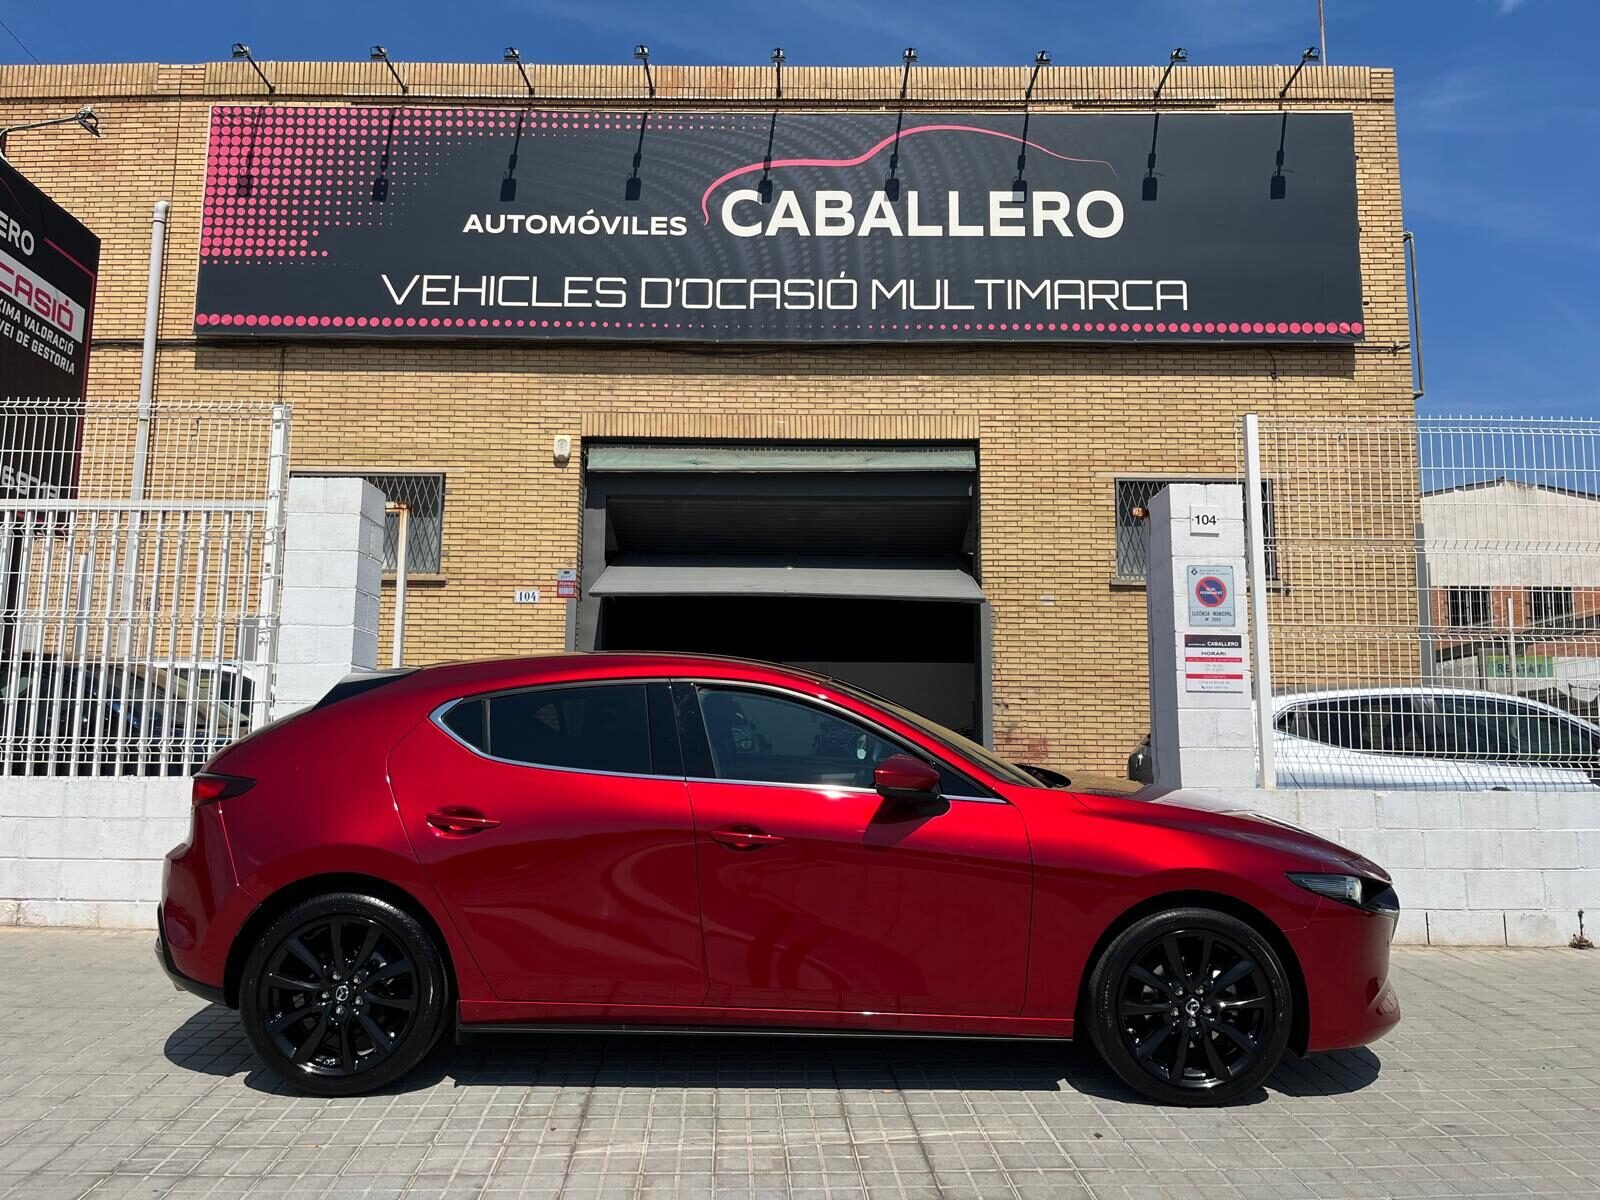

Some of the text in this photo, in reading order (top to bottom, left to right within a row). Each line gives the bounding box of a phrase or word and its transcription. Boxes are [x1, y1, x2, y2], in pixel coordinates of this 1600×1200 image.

[463, 189, 1124, 238] AUTOMÓVILES CABALLERO
[382, 271, 1187, 310] VEHICLES D'OCASIÓ MULTIMARCA
[16, 330, 30, 348] DE
[31, 339, 75, 375] GESTORIA
[24, 314, 74, 356] VALORACIÓ
[1194, 514, 1217, 525] 104
[519, 591, 537, 602] 104
